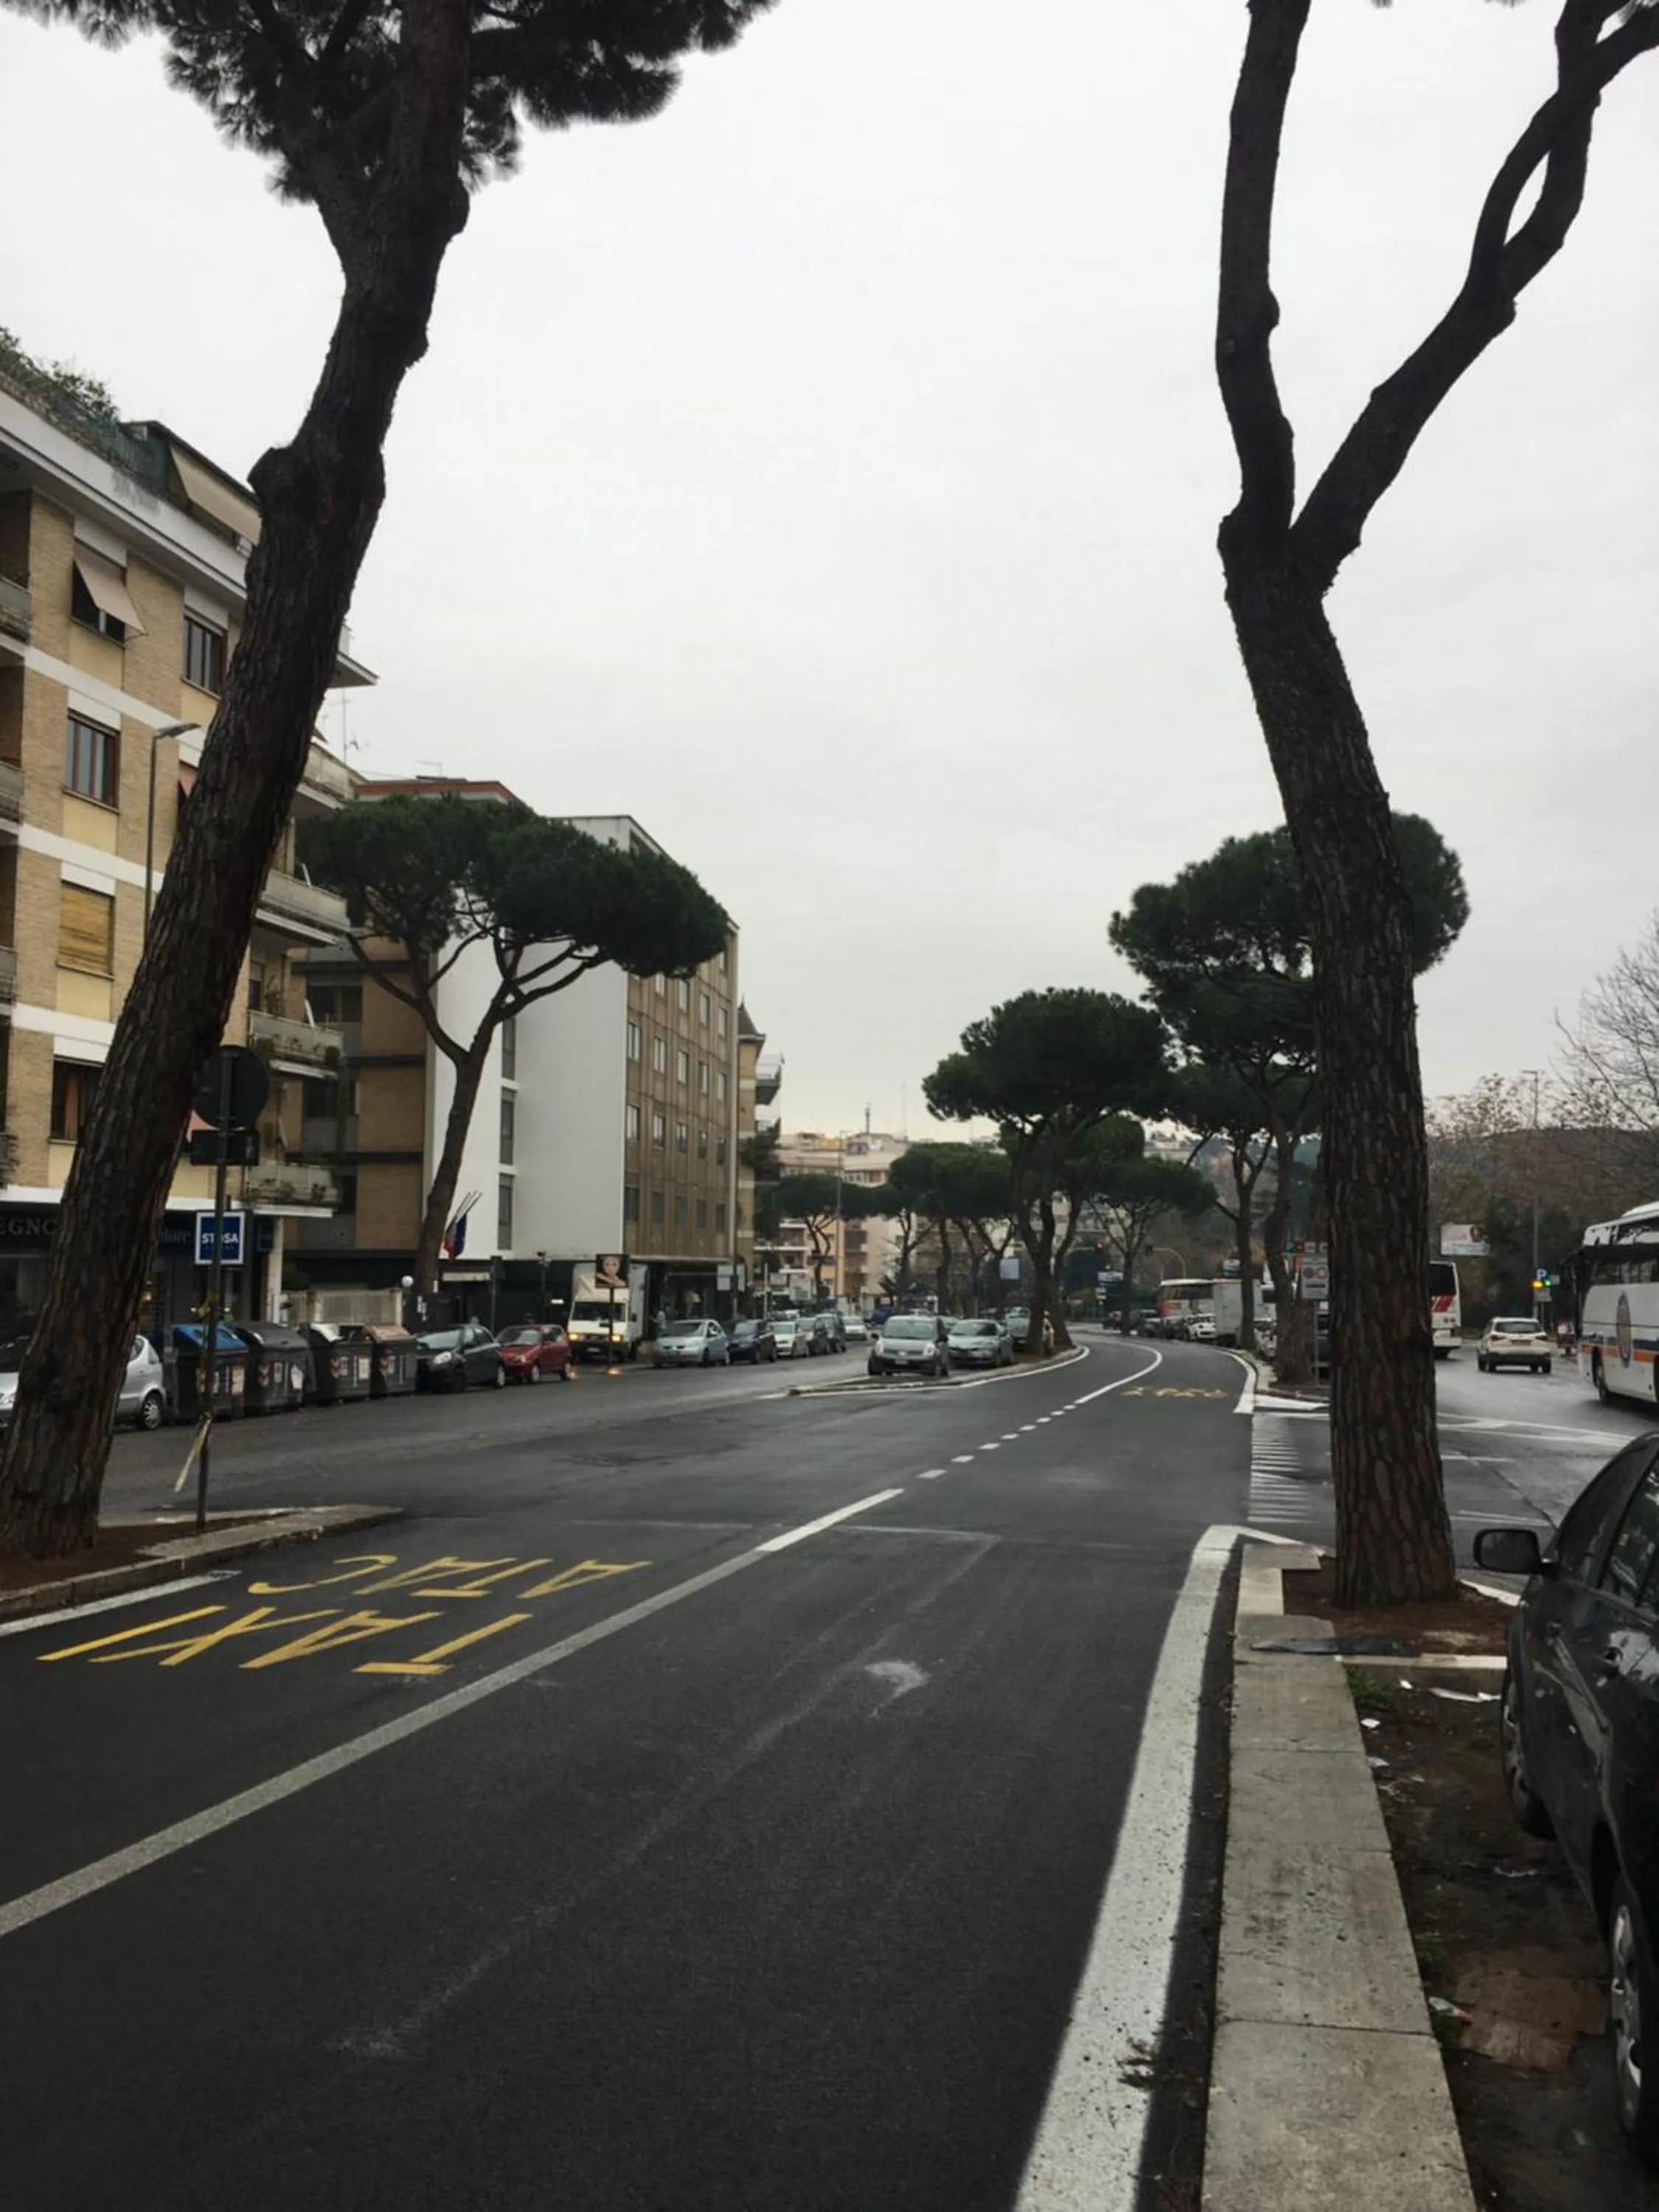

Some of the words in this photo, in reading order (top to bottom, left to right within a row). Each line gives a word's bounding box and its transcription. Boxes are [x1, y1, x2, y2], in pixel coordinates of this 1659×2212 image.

[201, 1232, 239, 1245] STSA
[1537, 1268, 1547, 1280] P
[248, 1554, 653, 1599] ATAC
[36, 1604, 534, 1676] TAXI
